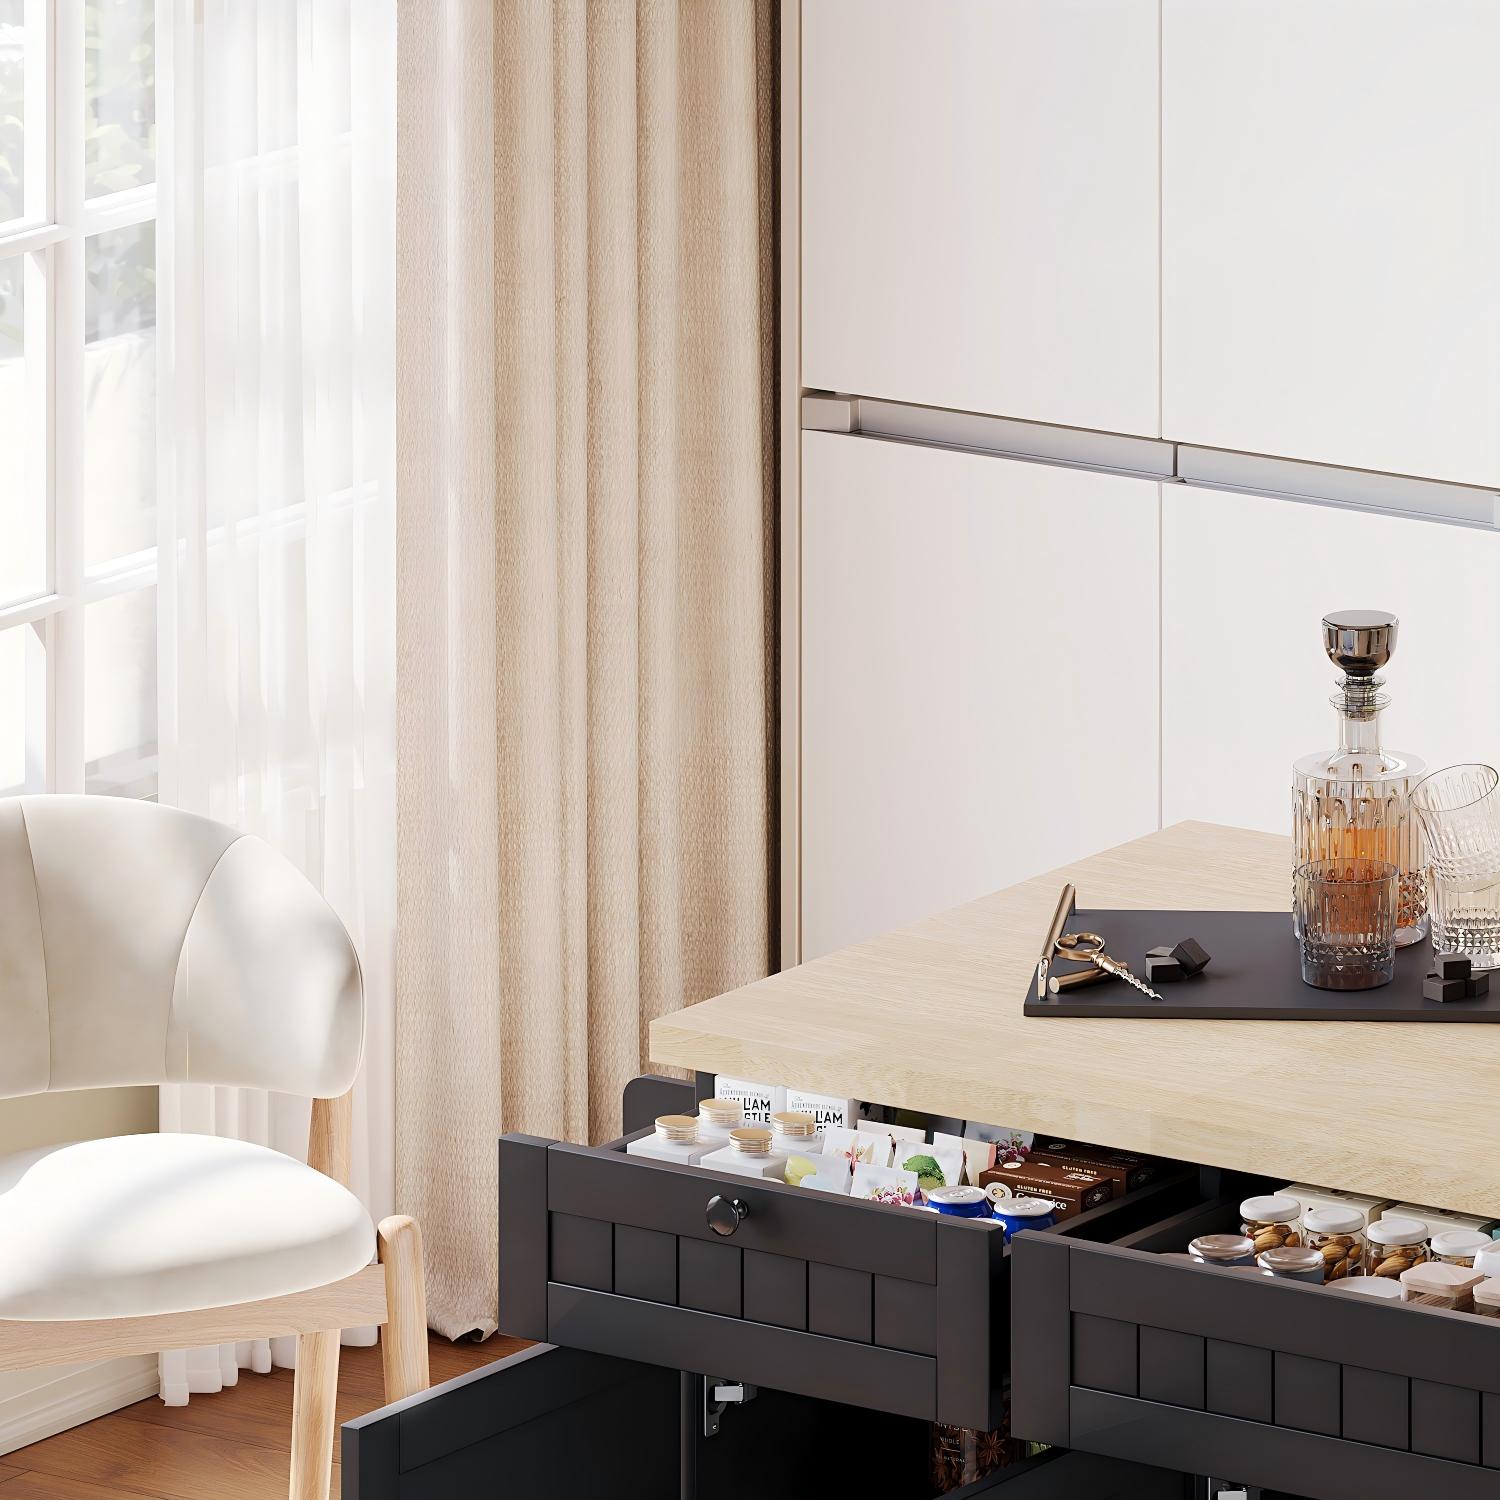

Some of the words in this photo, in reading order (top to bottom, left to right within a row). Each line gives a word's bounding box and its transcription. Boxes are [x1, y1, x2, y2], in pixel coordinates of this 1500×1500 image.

[1062, 1165, 1083, 1174] GLUTEN
[1016, 1184, 1037, 1193] GLUTEN
[1038, 1188, 1052, 1196] FREE
